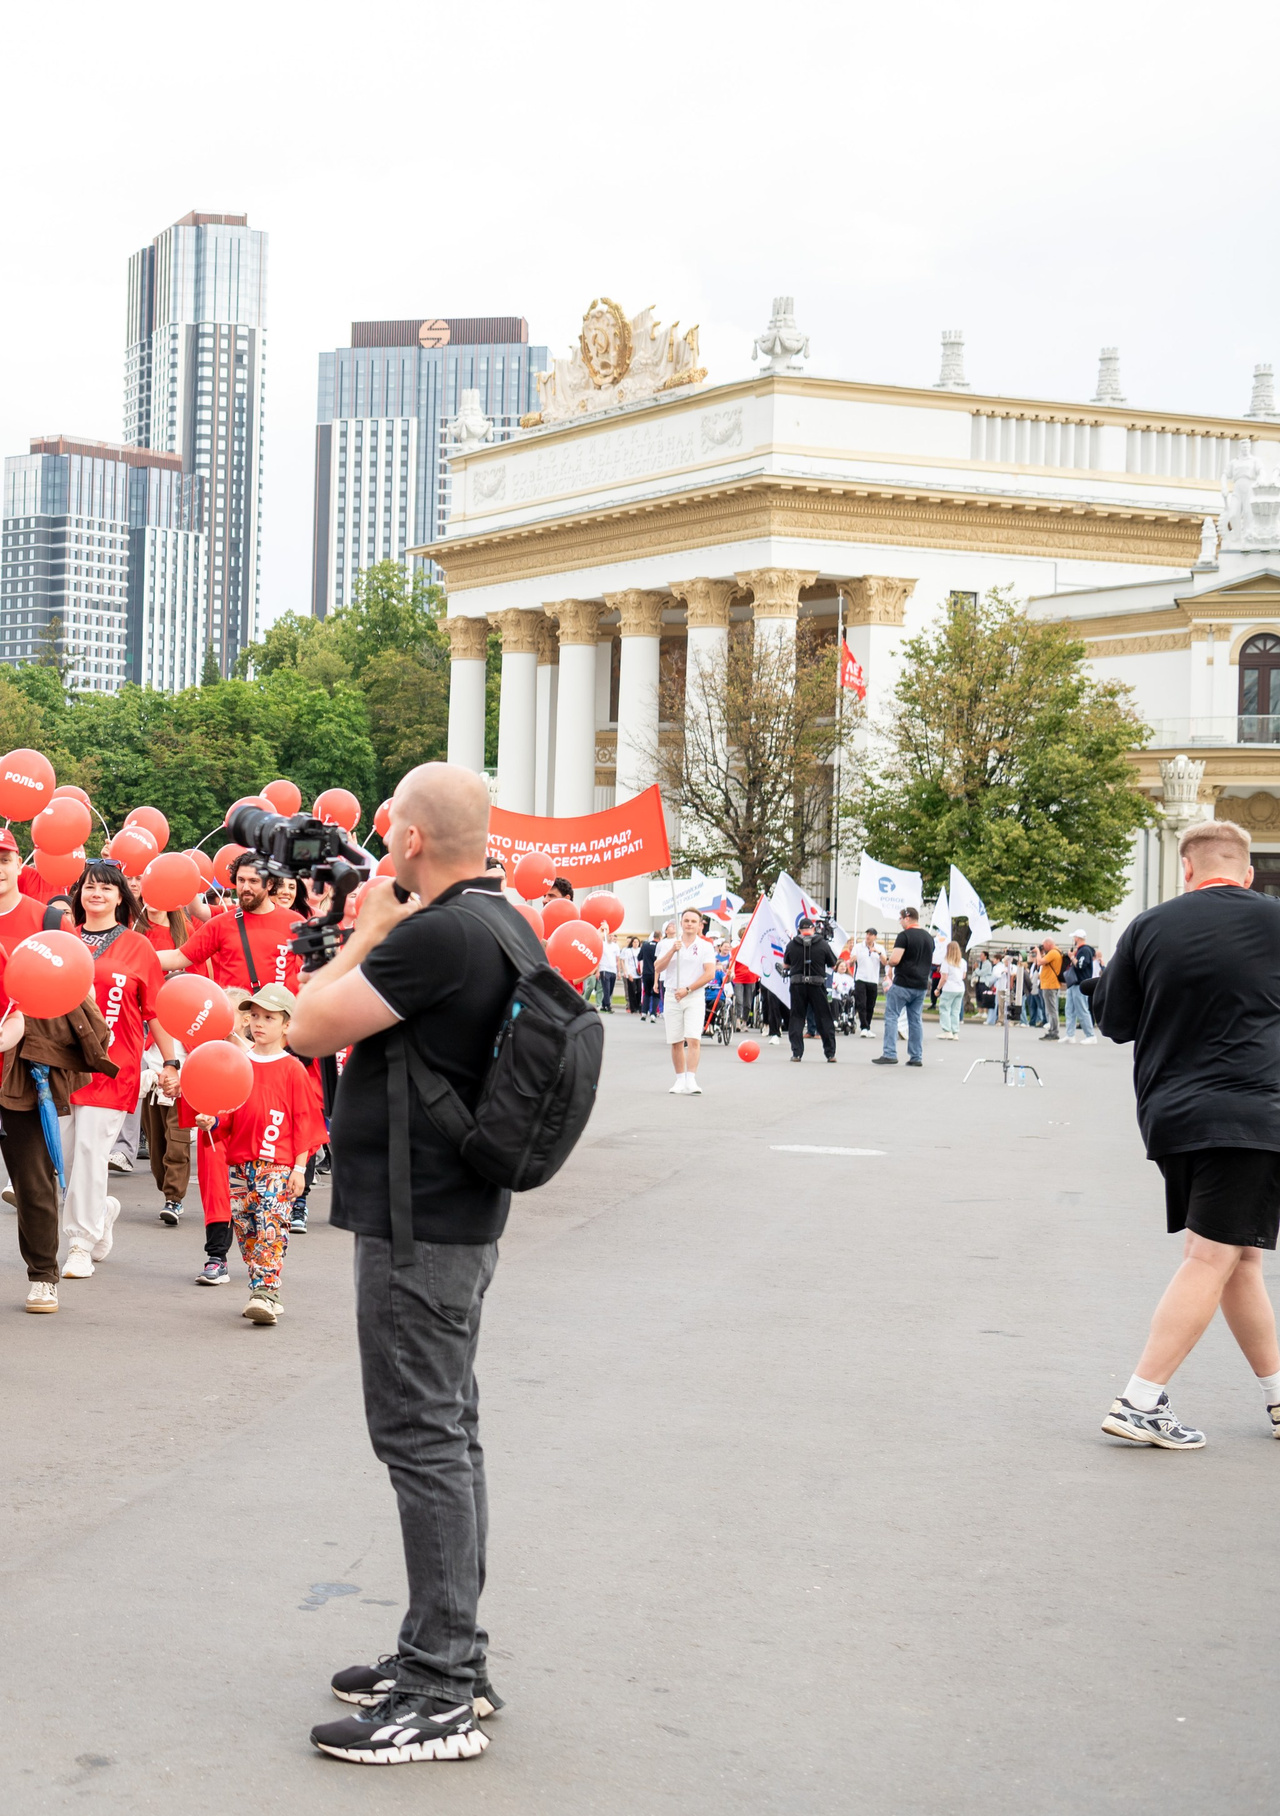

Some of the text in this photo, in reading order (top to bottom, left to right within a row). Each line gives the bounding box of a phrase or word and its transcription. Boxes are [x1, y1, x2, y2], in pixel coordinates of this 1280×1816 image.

[4, 771, 44, 791] РОЛЬФ
[125, 830, 152, 849] РОЛЬФ
[487, 829, 632, 854] КТО ШАГАЕТ НА ПАРАД?
[553, 838, 643, 867] СЕСТРА И БРАТ!
[20, 938, 64, 968] РОЛЬФ
[571, 939, 598, 965] РОЛЬФ
[104, 972, 127, 1048] РОЛЬФ
[186, 998, 213, 1038] РОЛЬФ
